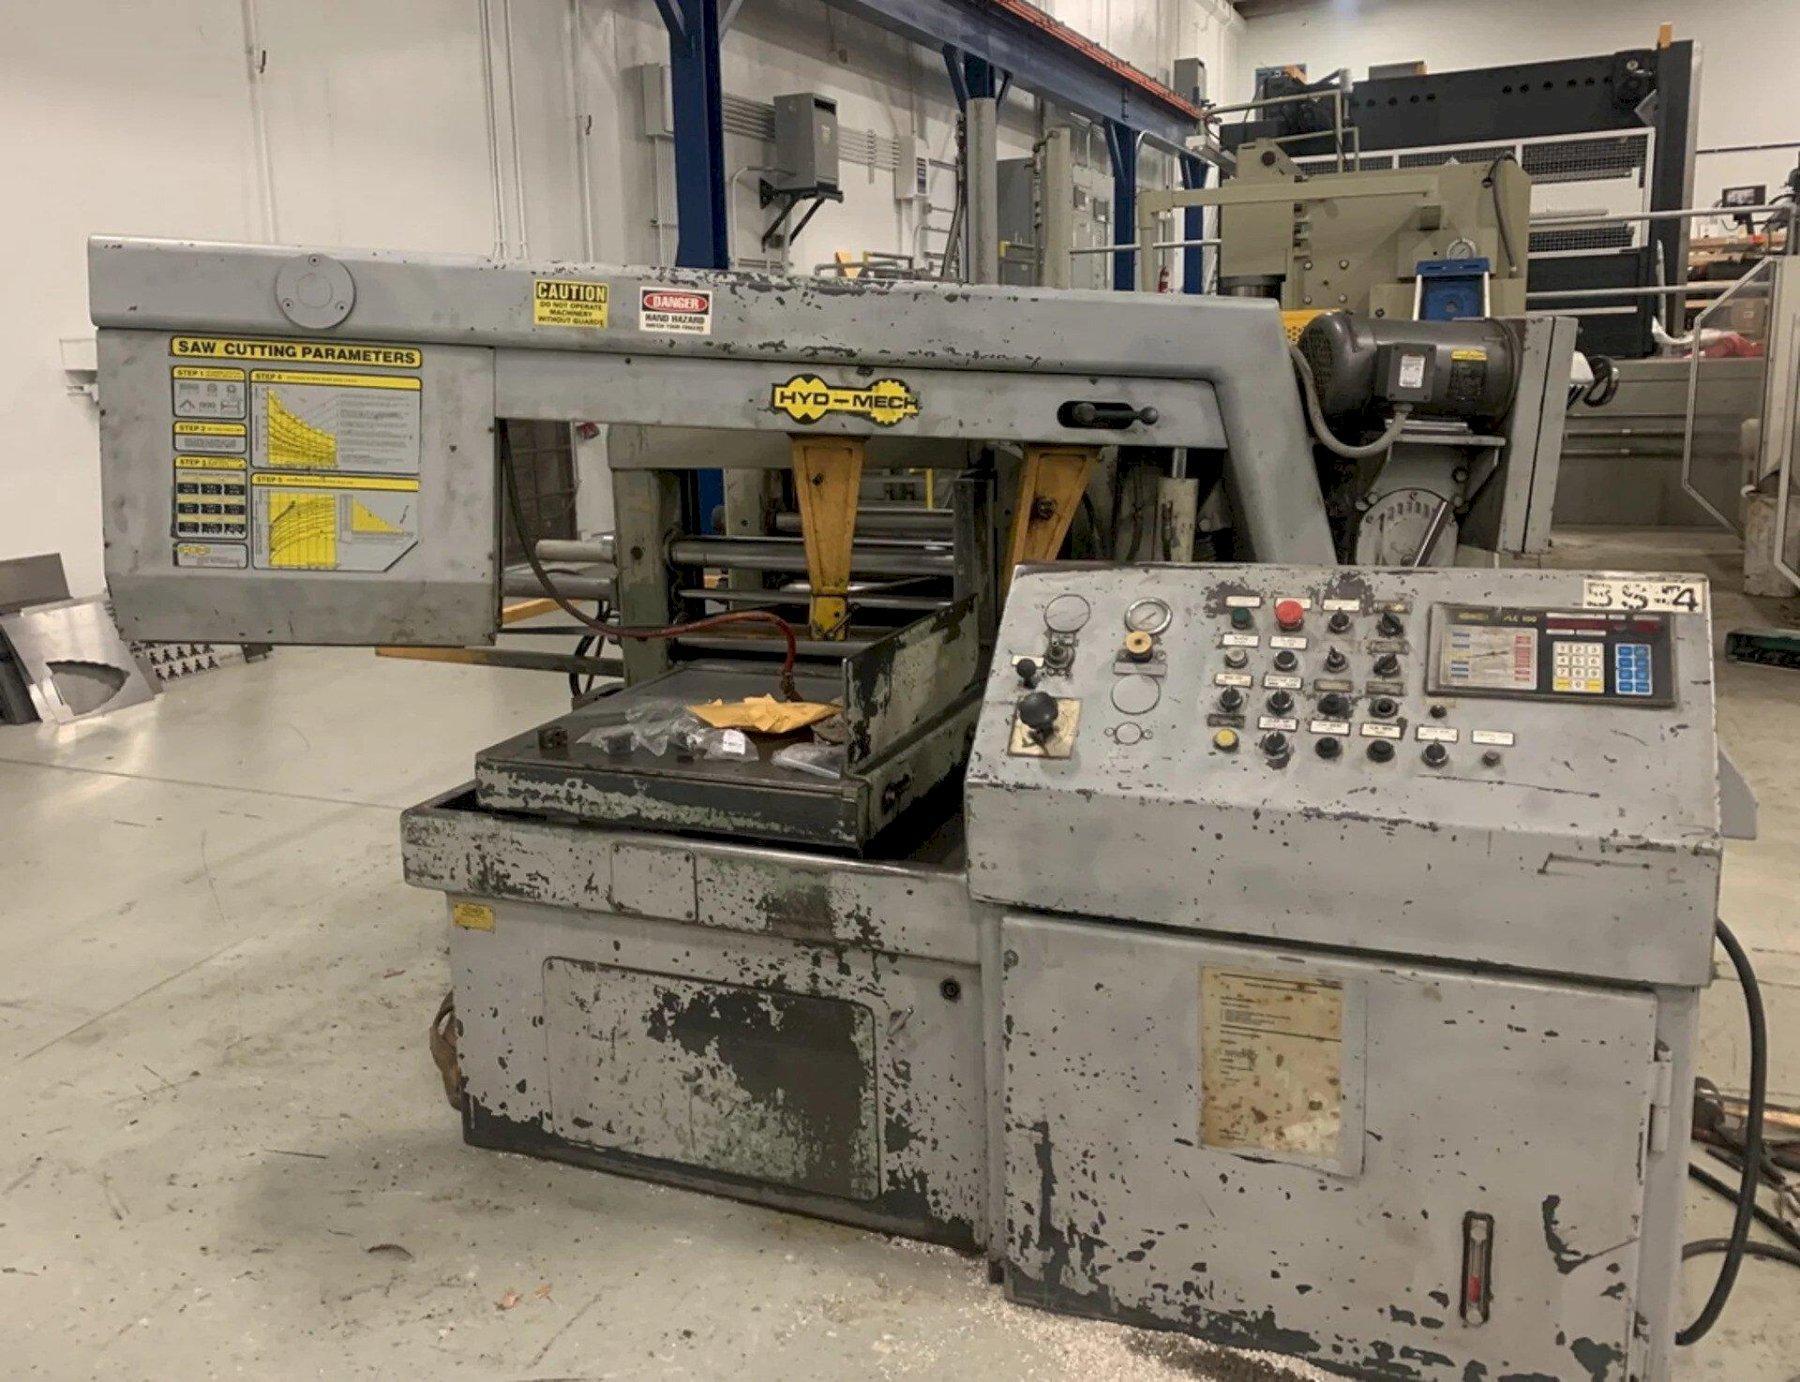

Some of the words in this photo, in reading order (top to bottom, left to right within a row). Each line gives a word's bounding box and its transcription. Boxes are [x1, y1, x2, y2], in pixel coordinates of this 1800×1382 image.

[538, 283, 605, 301] CAUTION
[653, 296, 699, 309] DANGER
[179, 341, 217, 354] SAW
[224, 342, 296, 357] CUTTING
[301, 345, 416, 365] PARAMETERS
